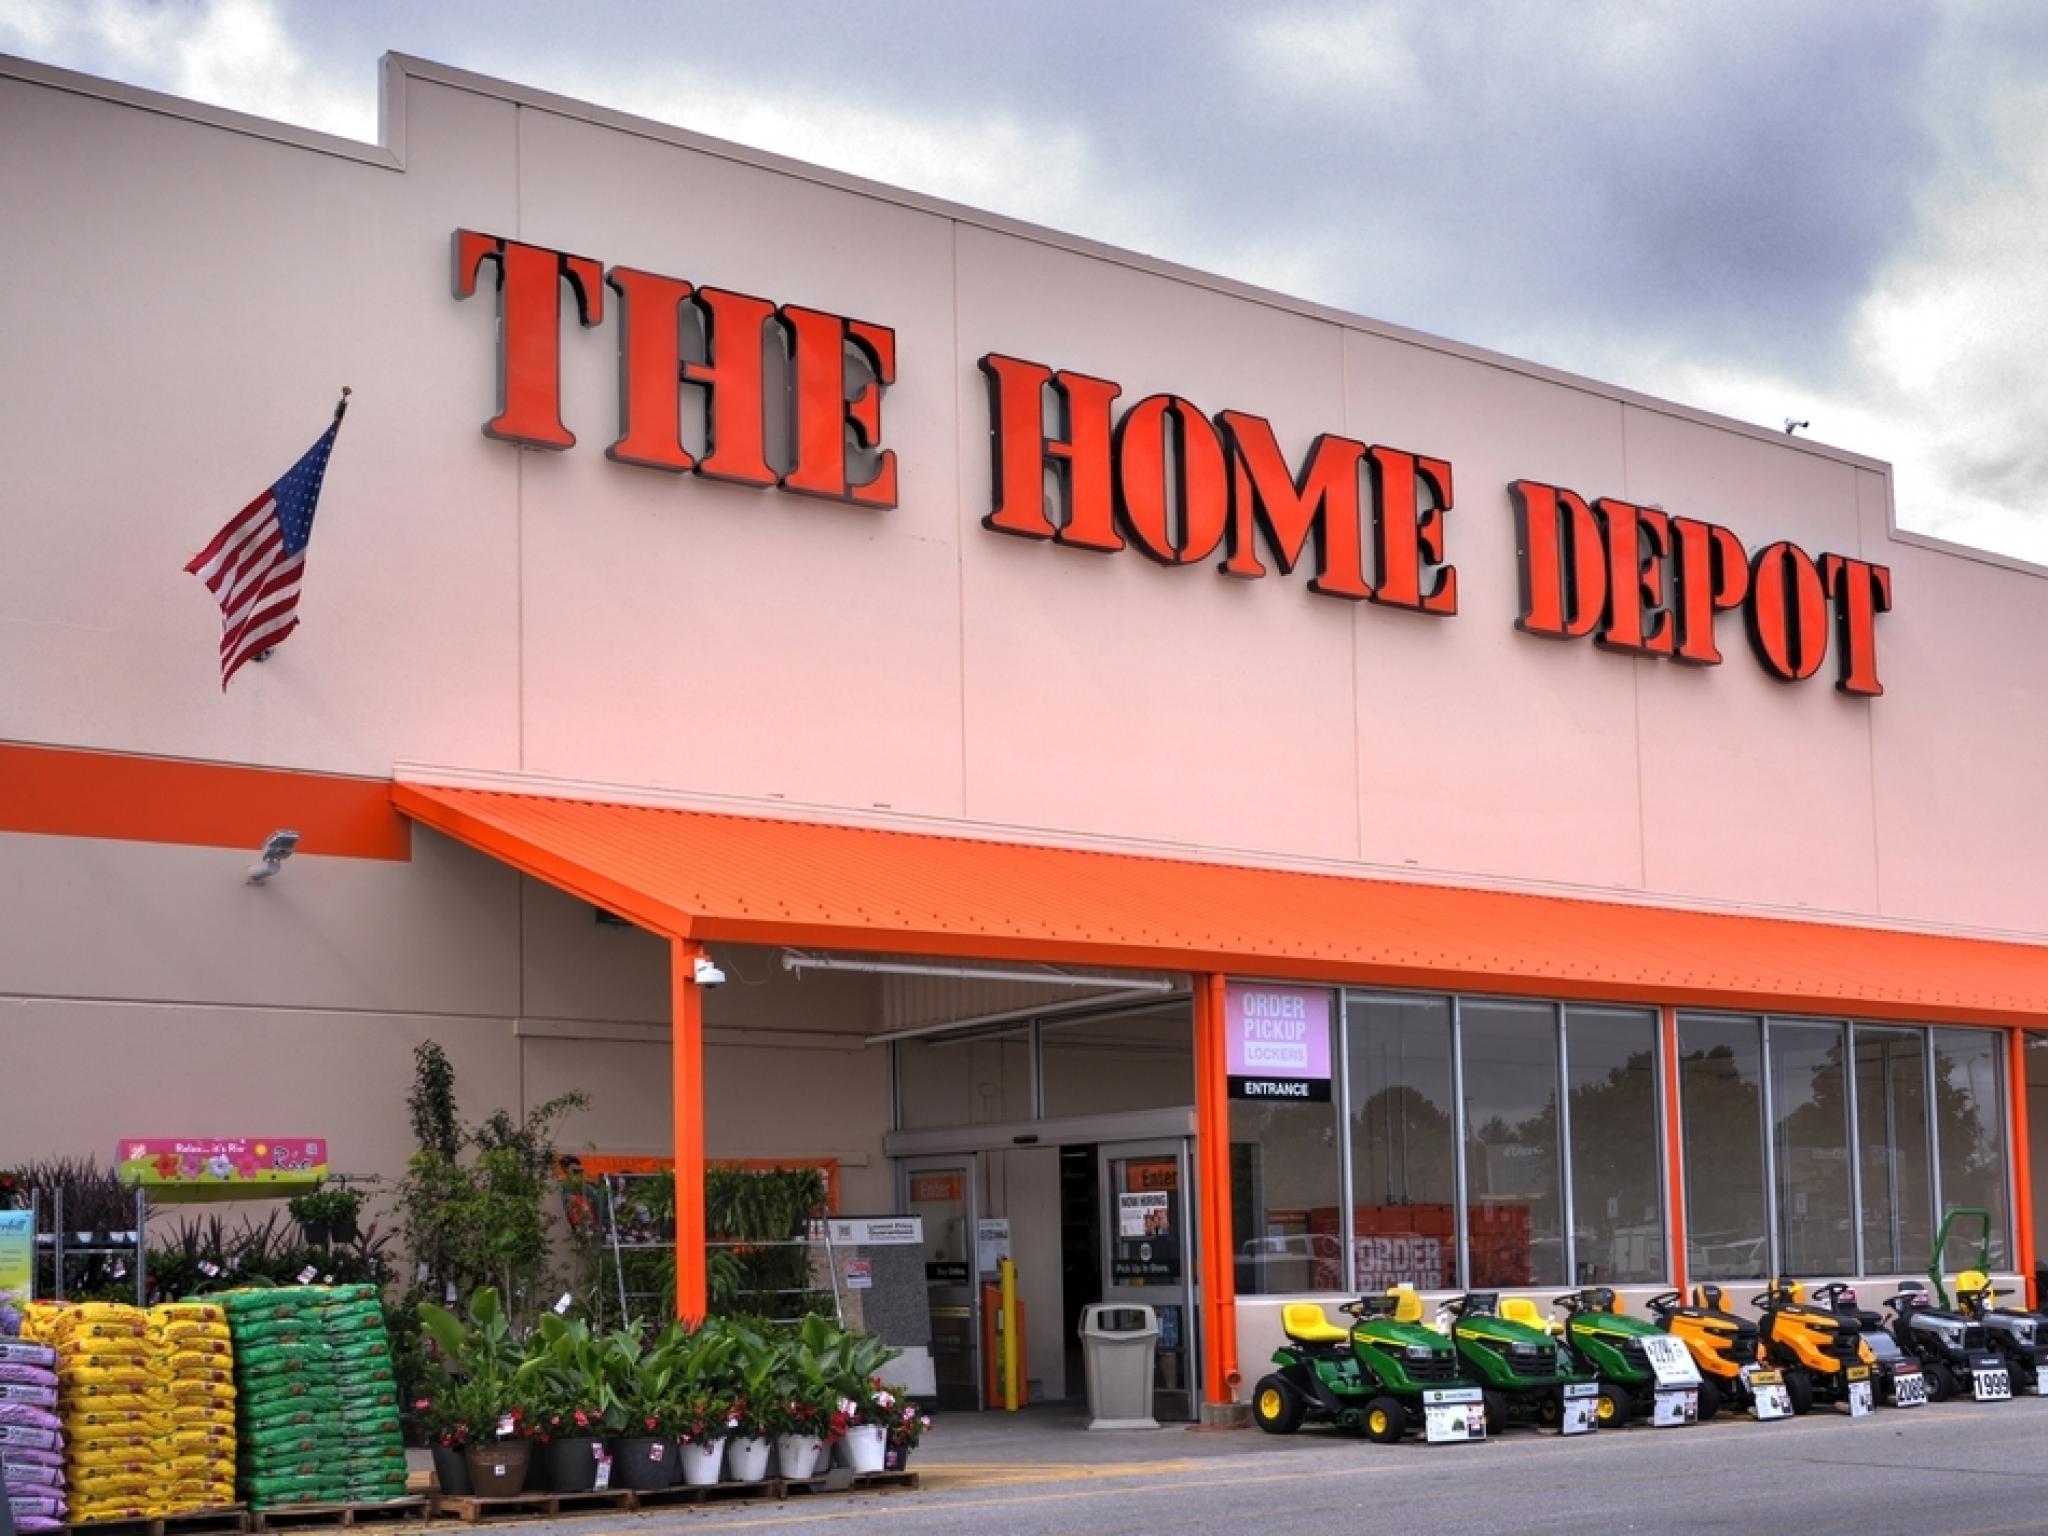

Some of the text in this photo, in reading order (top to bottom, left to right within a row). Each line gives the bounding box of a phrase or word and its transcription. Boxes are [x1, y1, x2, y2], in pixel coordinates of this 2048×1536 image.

[451, 228, 1892, 695] THE HOME DEPOT
[1244, 991, 1305, 1018] ORDER
[1244, 1019, 1306, 1040] PICKUP
[1248, 1047, 1305, 1062] LOCKERS
[1244, 1081, 1310, 1096] ENTRANCE
[1142, 1167, 1178, 1187] Enter
[1358, 1237, 1440, 1271] ORDER
[1976, 1373, 2009, 1396] 1999
